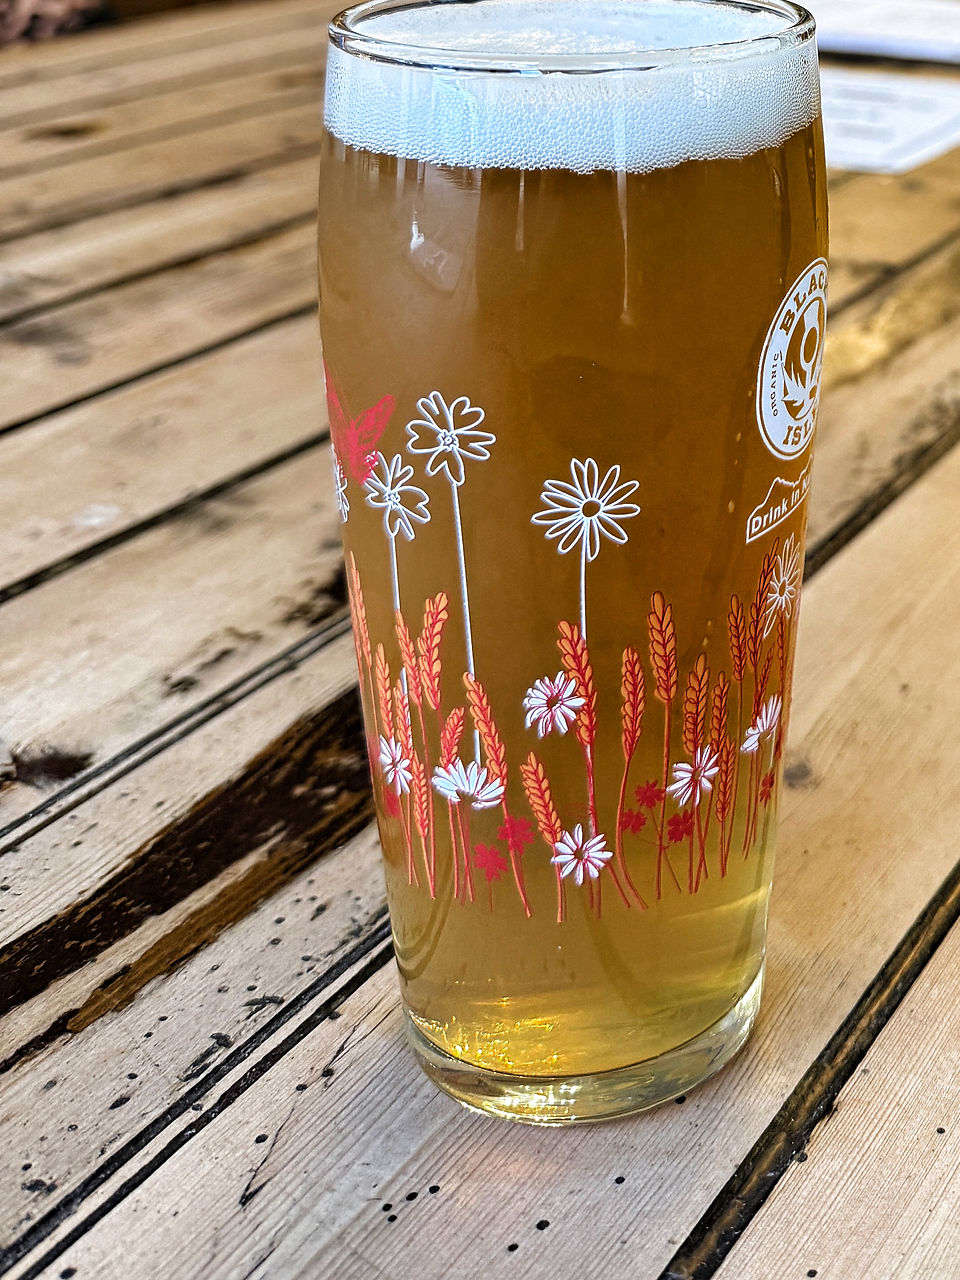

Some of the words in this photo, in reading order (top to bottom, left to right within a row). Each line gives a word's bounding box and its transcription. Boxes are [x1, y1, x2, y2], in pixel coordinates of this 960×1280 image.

[779, 270, 828, 336] BLAC
[770, 353, 780, 417] ORGANIC
[751, 497, 788, 535] Drink
